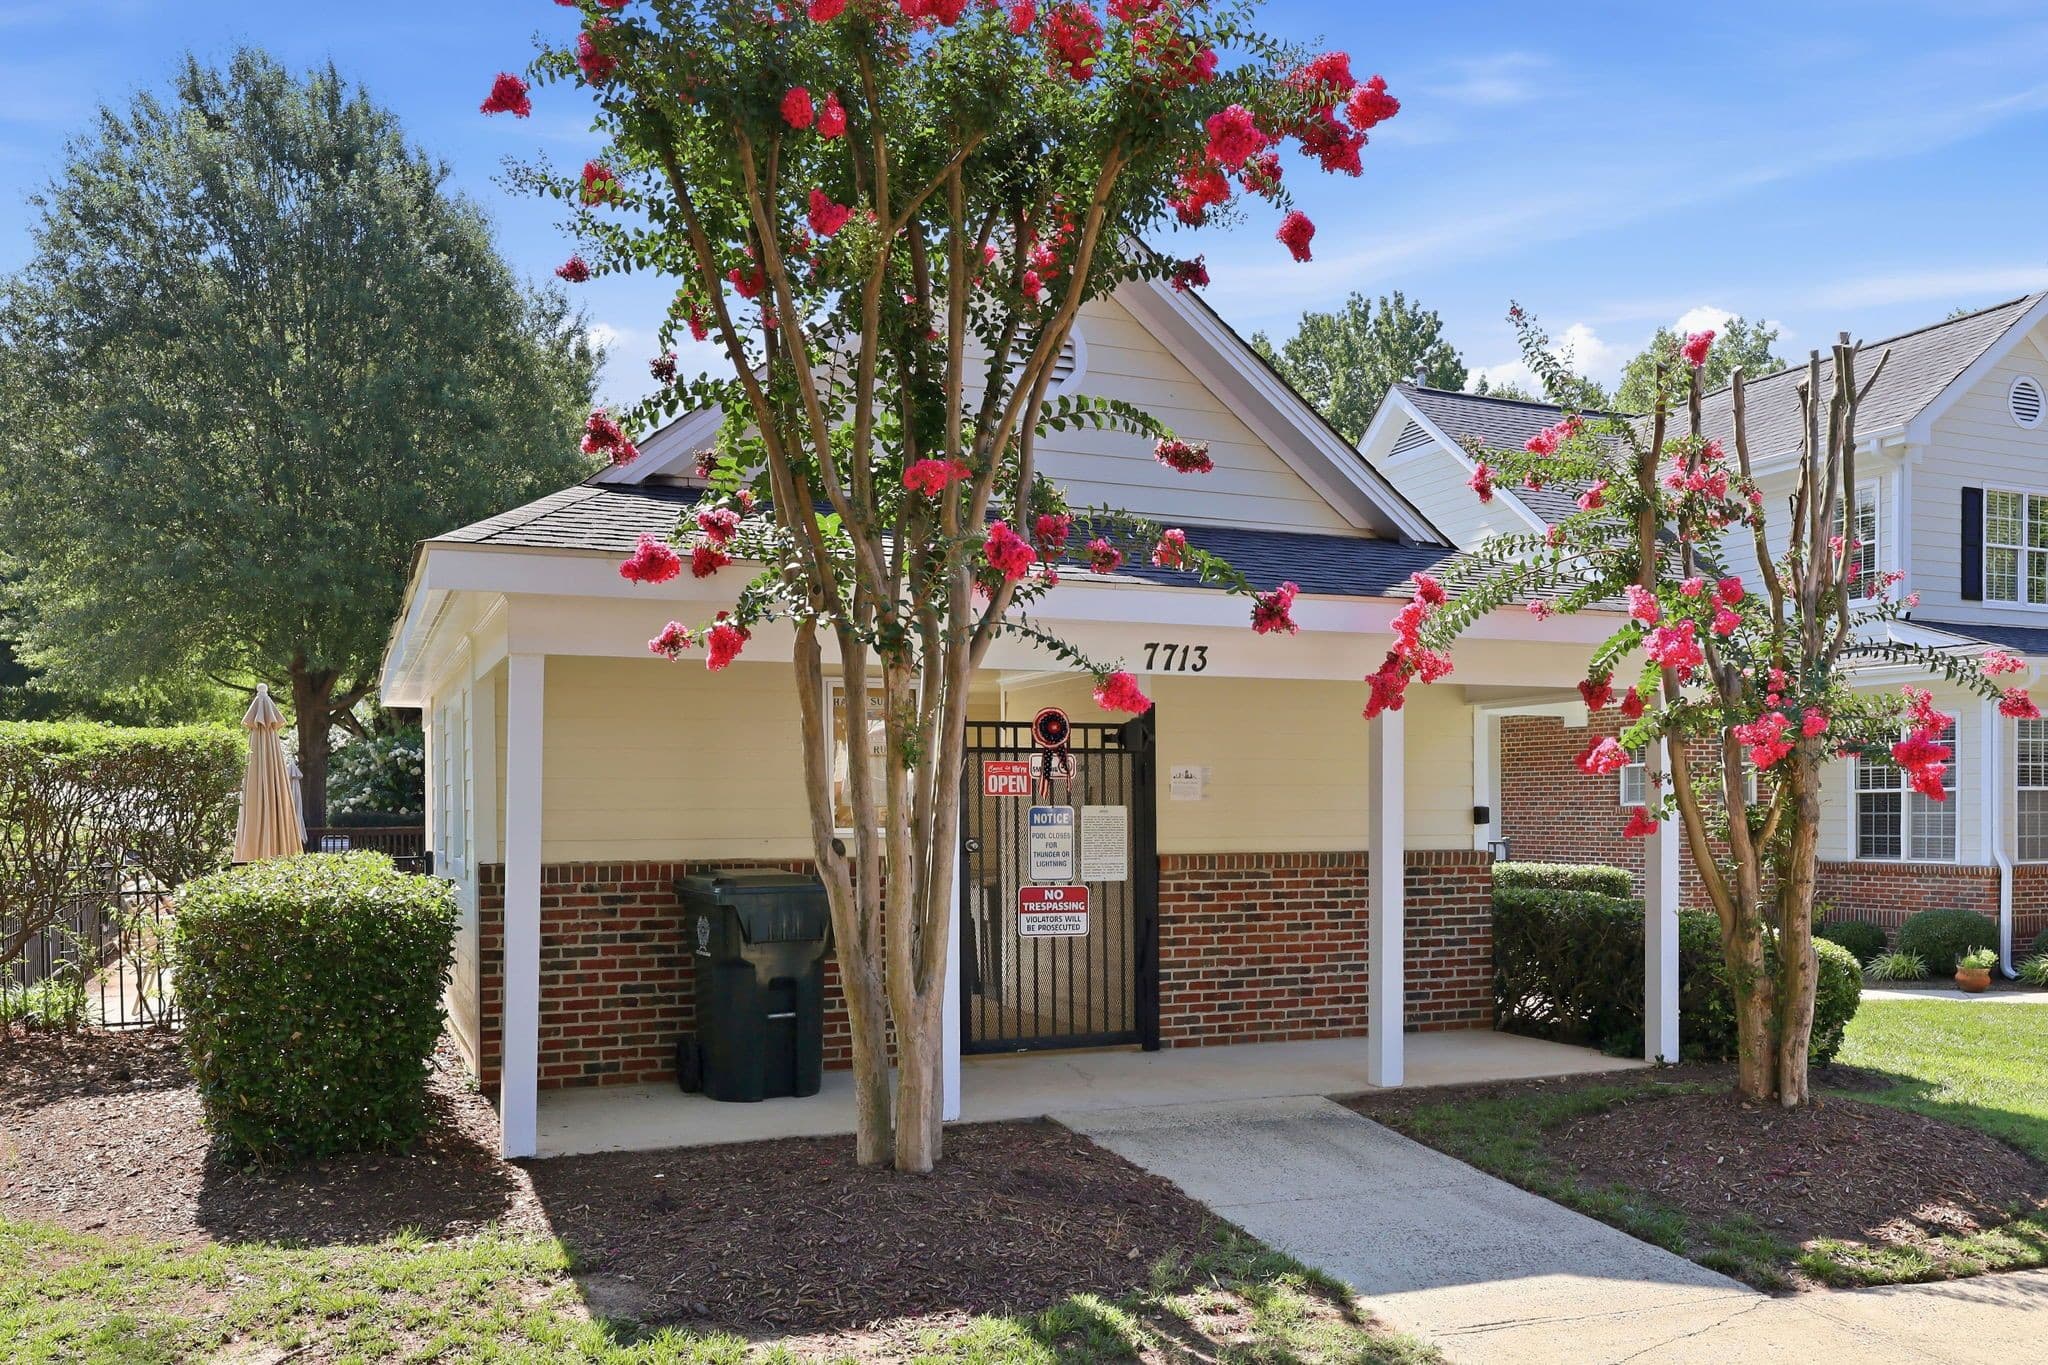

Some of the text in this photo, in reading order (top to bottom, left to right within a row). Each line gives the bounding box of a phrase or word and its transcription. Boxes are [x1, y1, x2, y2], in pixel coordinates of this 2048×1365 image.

[1143, 642, 1209, 672] 7713
[988, 775, 1028, 793] OPEN
[1033, 813, 1069, 824] NOTICE
[1044, 889, 1064, 900] NO
[1022, 901, 1085, 911] TRESPASSING
[1026, 915, 1063, 923] VIOLATORS
[1038, 923, 1080, 931] PROSECUTED
